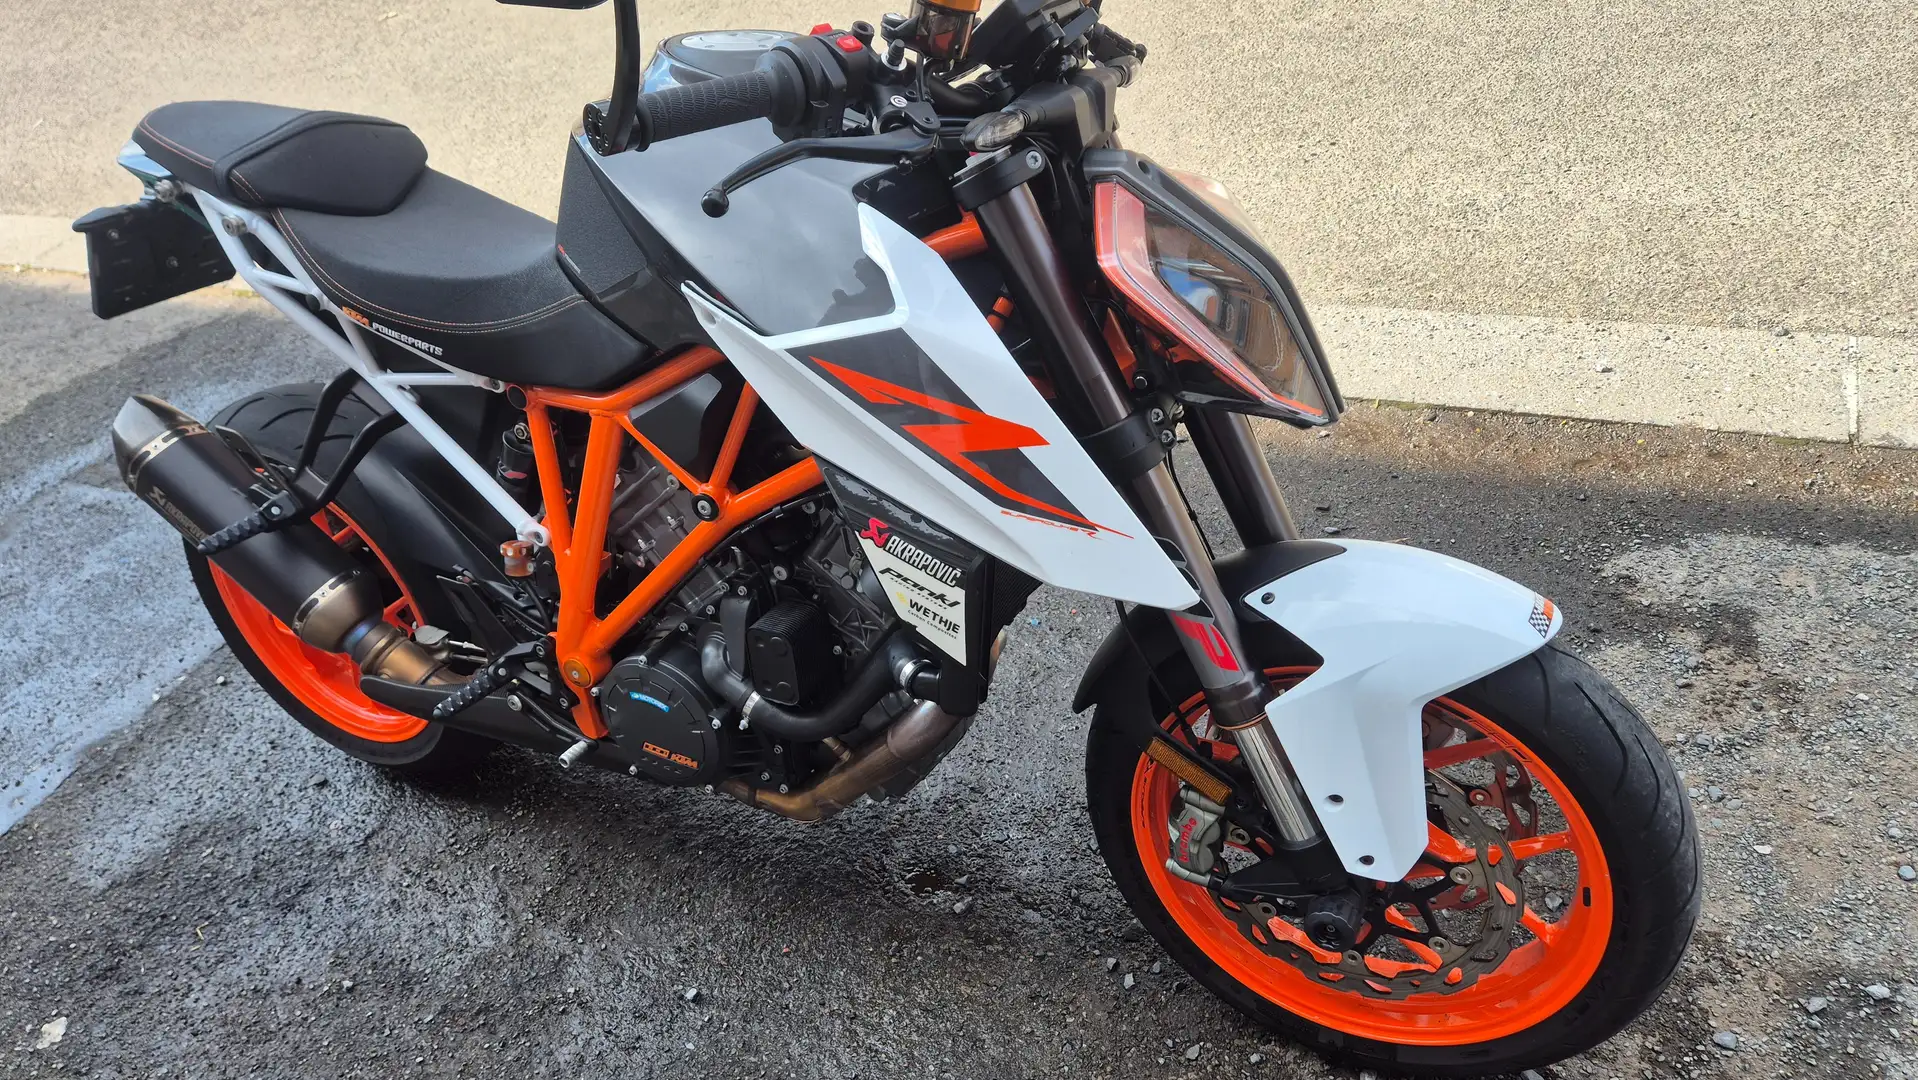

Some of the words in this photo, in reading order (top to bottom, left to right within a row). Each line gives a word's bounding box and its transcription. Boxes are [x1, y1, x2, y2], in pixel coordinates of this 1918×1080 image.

[372, 322, 443, 356] POWERPARTS
[909, 598, 961, 634] WETHJE
[1179, 817, 1197, 863] brembo
